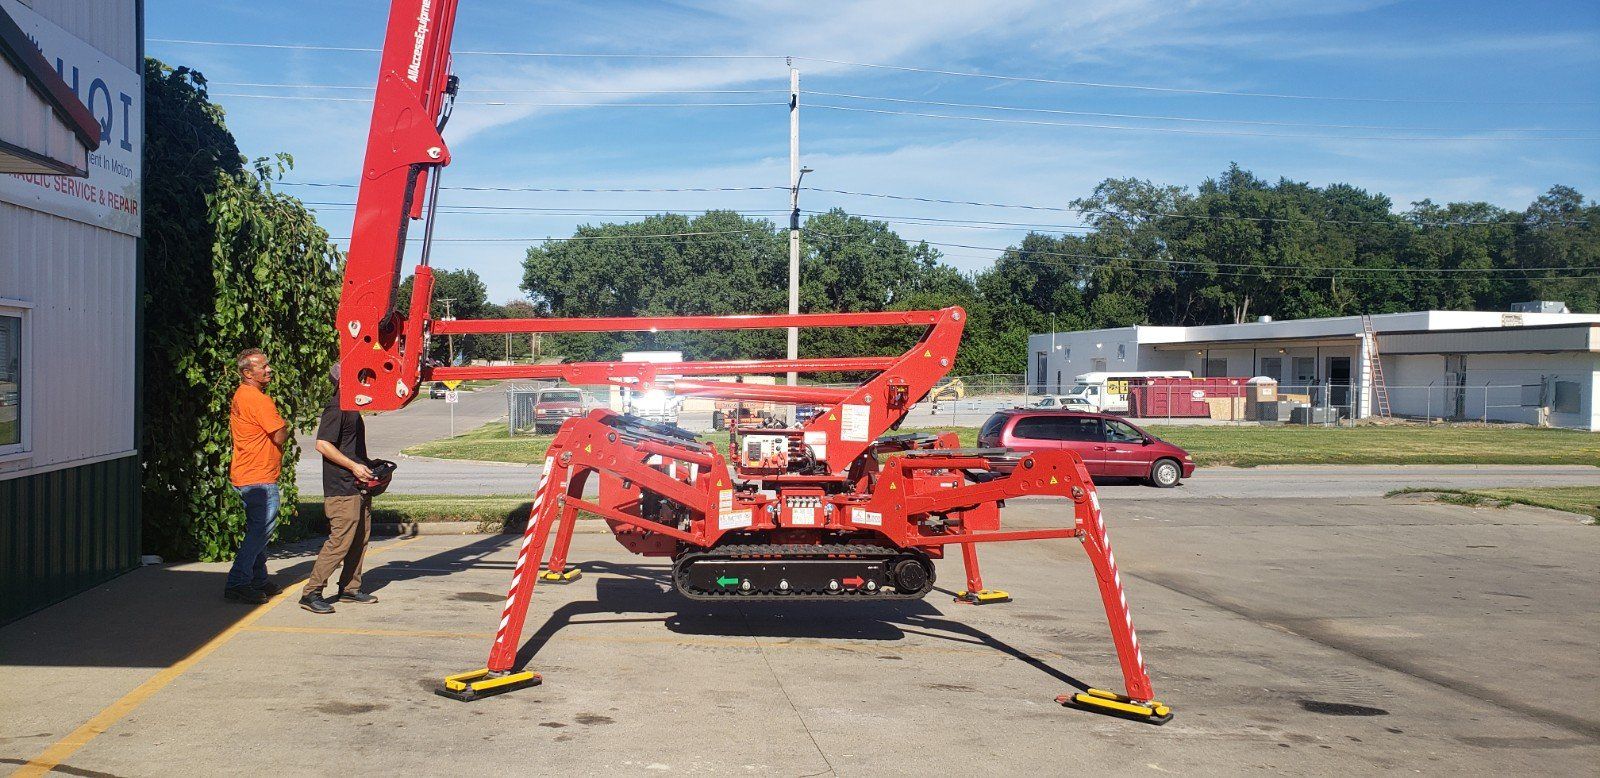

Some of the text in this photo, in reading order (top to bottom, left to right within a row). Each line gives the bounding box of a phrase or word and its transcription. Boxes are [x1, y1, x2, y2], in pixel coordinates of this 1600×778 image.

[88, 151, 133, 179] ent In Motion
[9, 173, 138, 215] ULIC SERVICE & REPAIR
